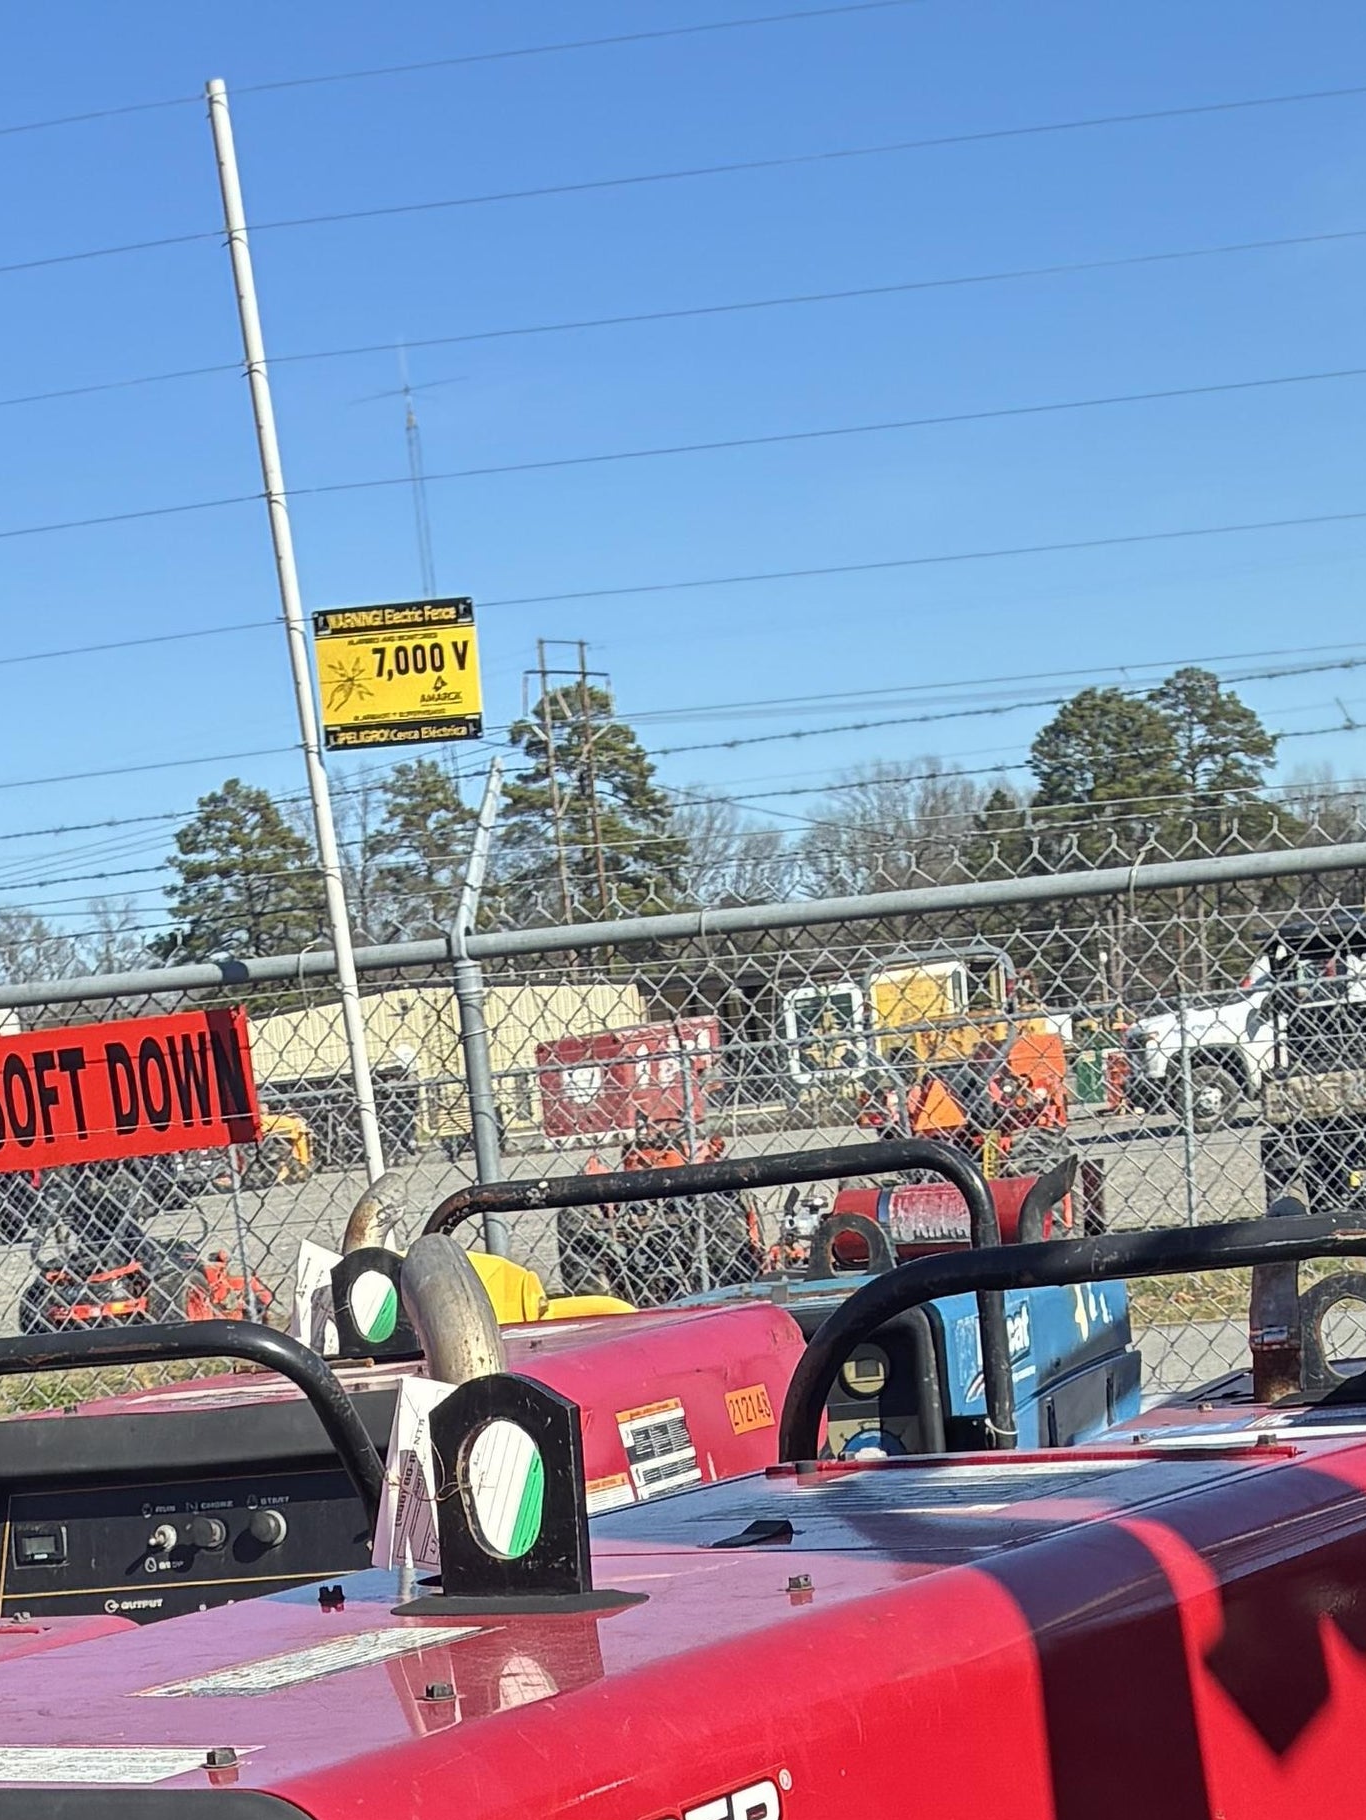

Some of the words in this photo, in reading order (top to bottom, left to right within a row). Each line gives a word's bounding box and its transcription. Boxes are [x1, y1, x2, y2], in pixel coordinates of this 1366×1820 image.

[372, 642, 445, 682] 7,000
[451, 640, 469, 671] V
[104, 1028, 252, 1136] DOWN
